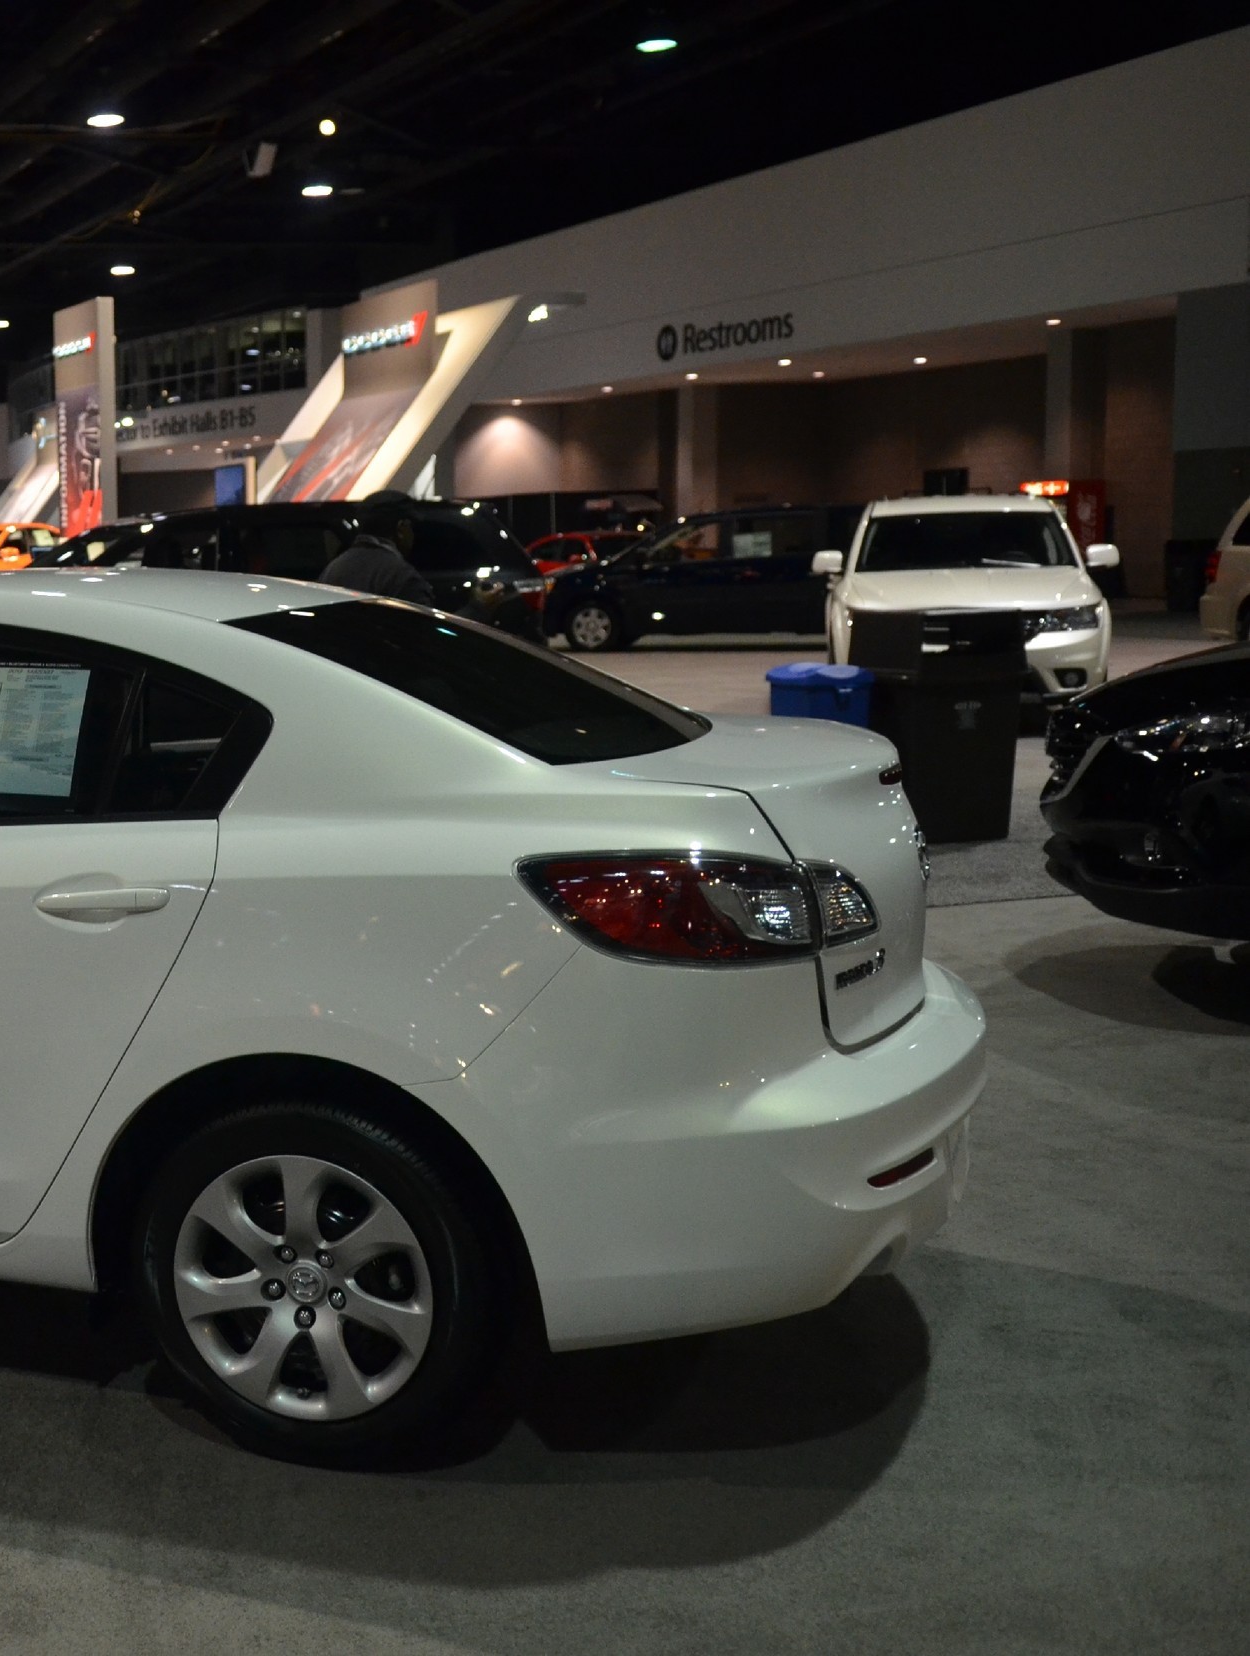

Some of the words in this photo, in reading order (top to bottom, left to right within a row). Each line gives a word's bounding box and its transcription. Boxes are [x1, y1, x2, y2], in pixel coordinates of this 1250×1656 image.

[683, 312, 794, 354] Restrooms
[152, 414, 187, 438] Exhibit
[190, 409, 218, 433] Halls
[59, 401, 68, 528] INFORMATION
